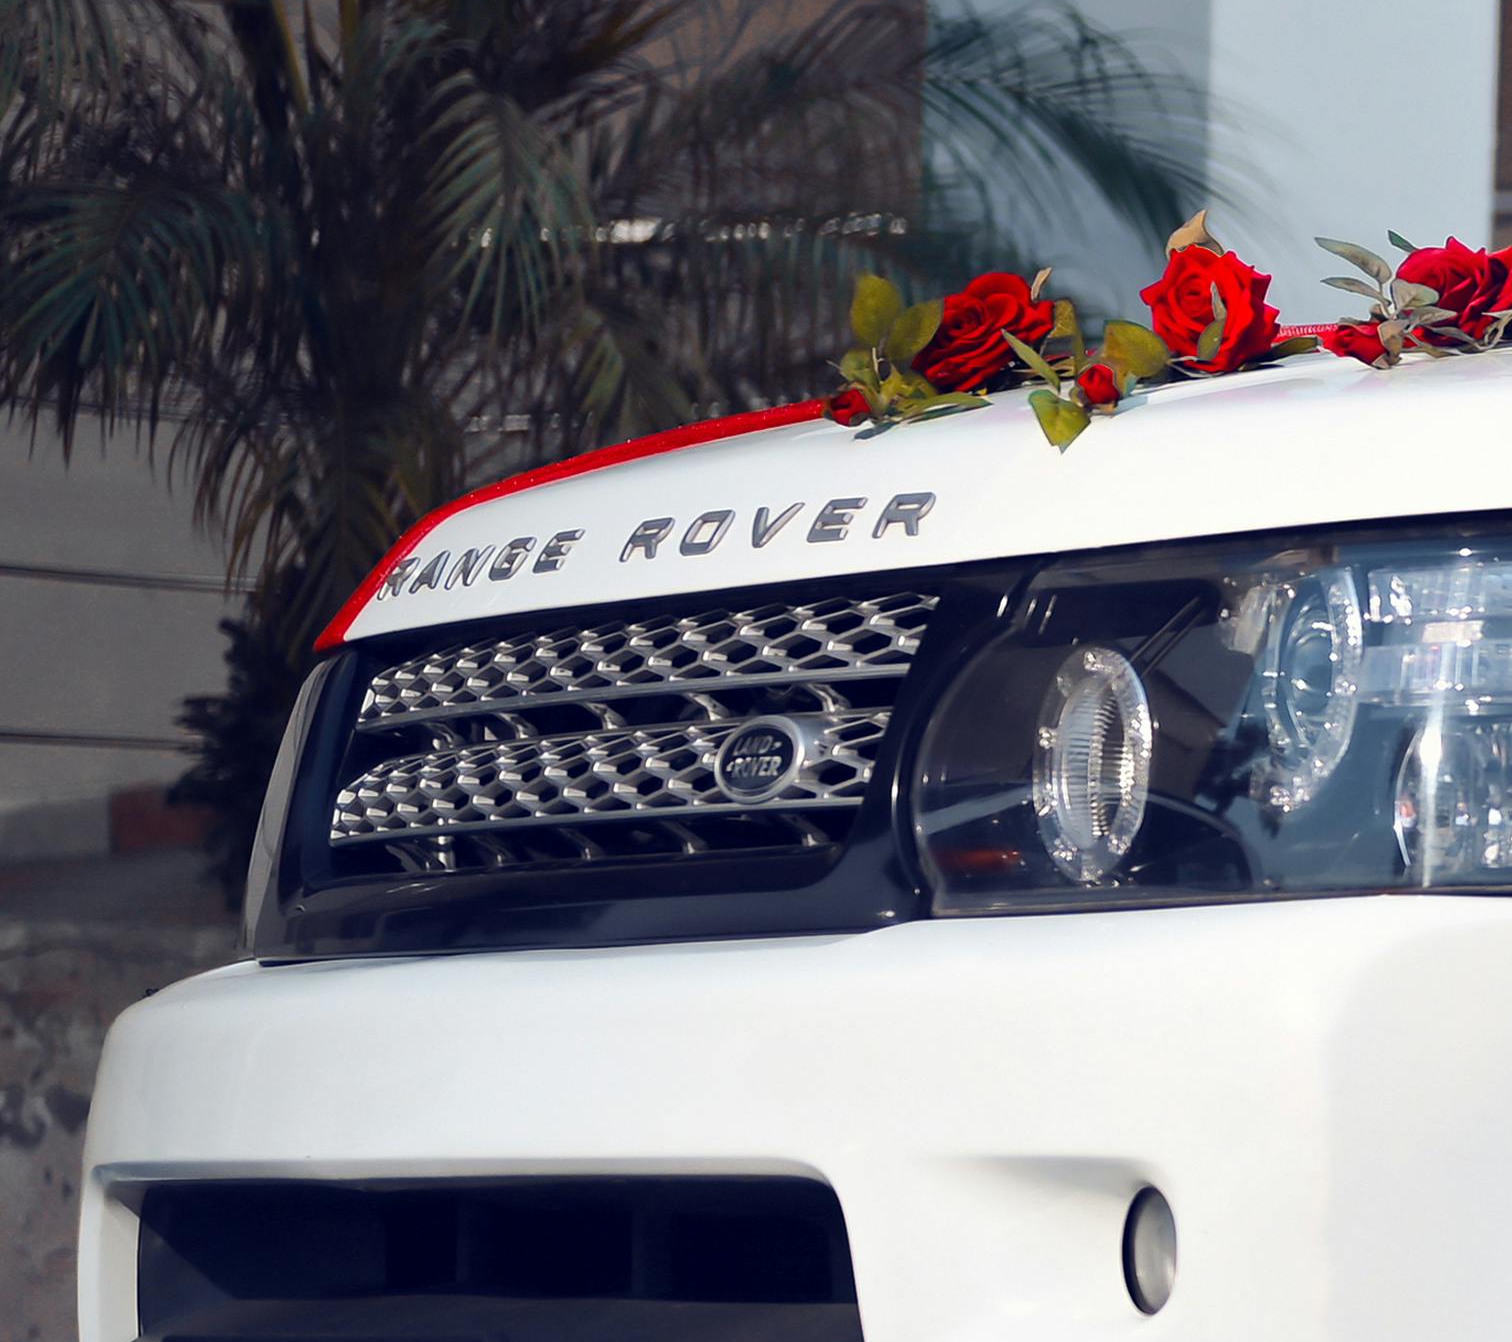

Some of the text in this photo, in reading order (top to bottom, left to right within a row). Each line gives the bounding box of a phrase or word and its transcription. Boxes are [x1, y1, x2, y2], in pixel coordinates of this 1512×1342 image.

[377, 491, 937, 601] RANGE ROVER
[731, 755, 782, 778] ROVER
